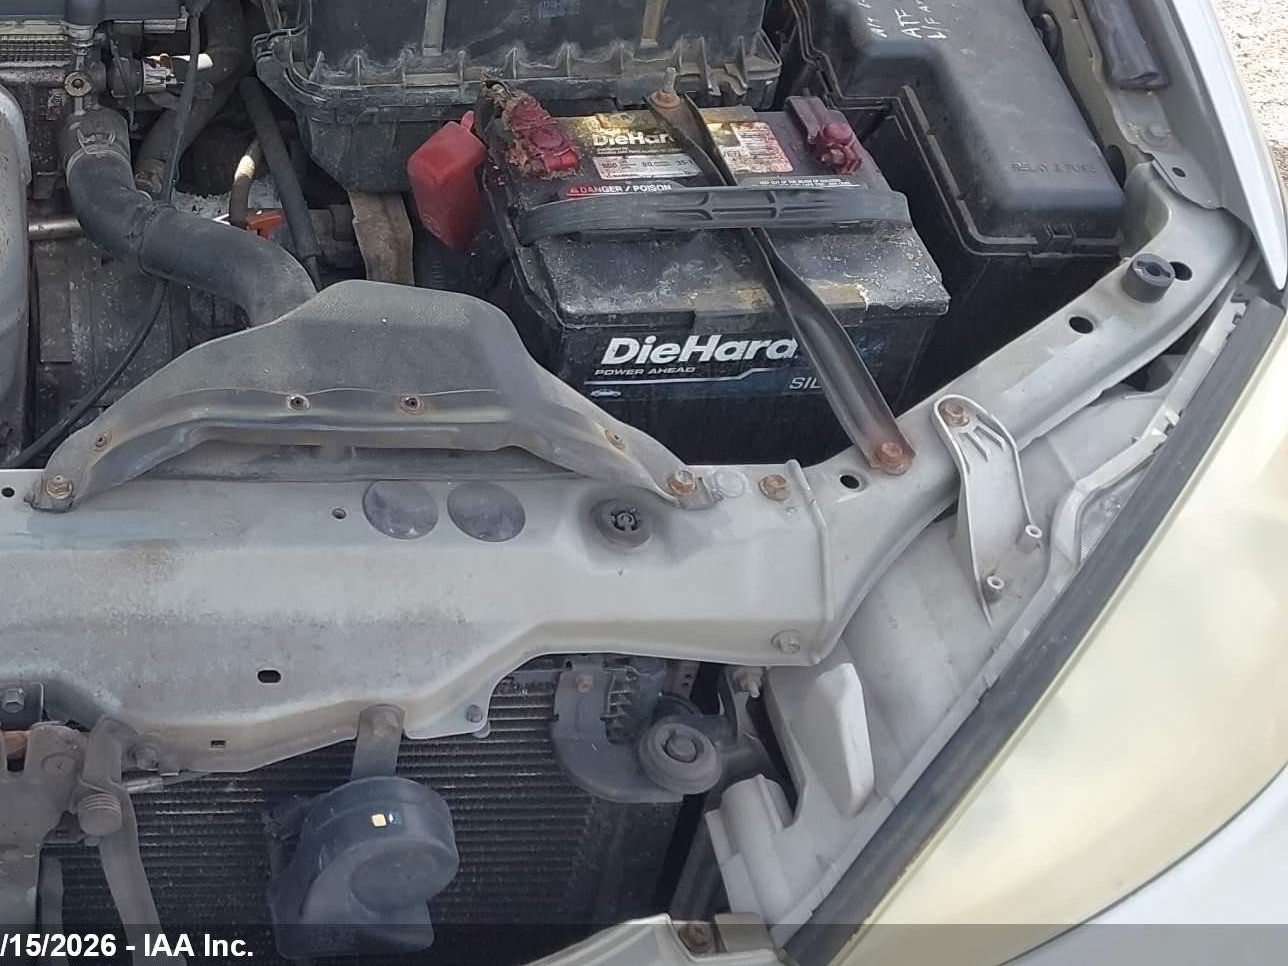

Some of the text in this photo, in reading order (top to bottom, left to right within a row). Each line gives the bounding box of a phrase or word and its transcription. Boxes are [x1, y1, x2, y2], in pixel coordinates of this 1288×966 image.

[580, 185, 623, 194] DANGER
[633, 184, 672, 193] POISON
[593, 366, 696, 376] POWER AHEAD
[789, 376, 823, 391] SIL
